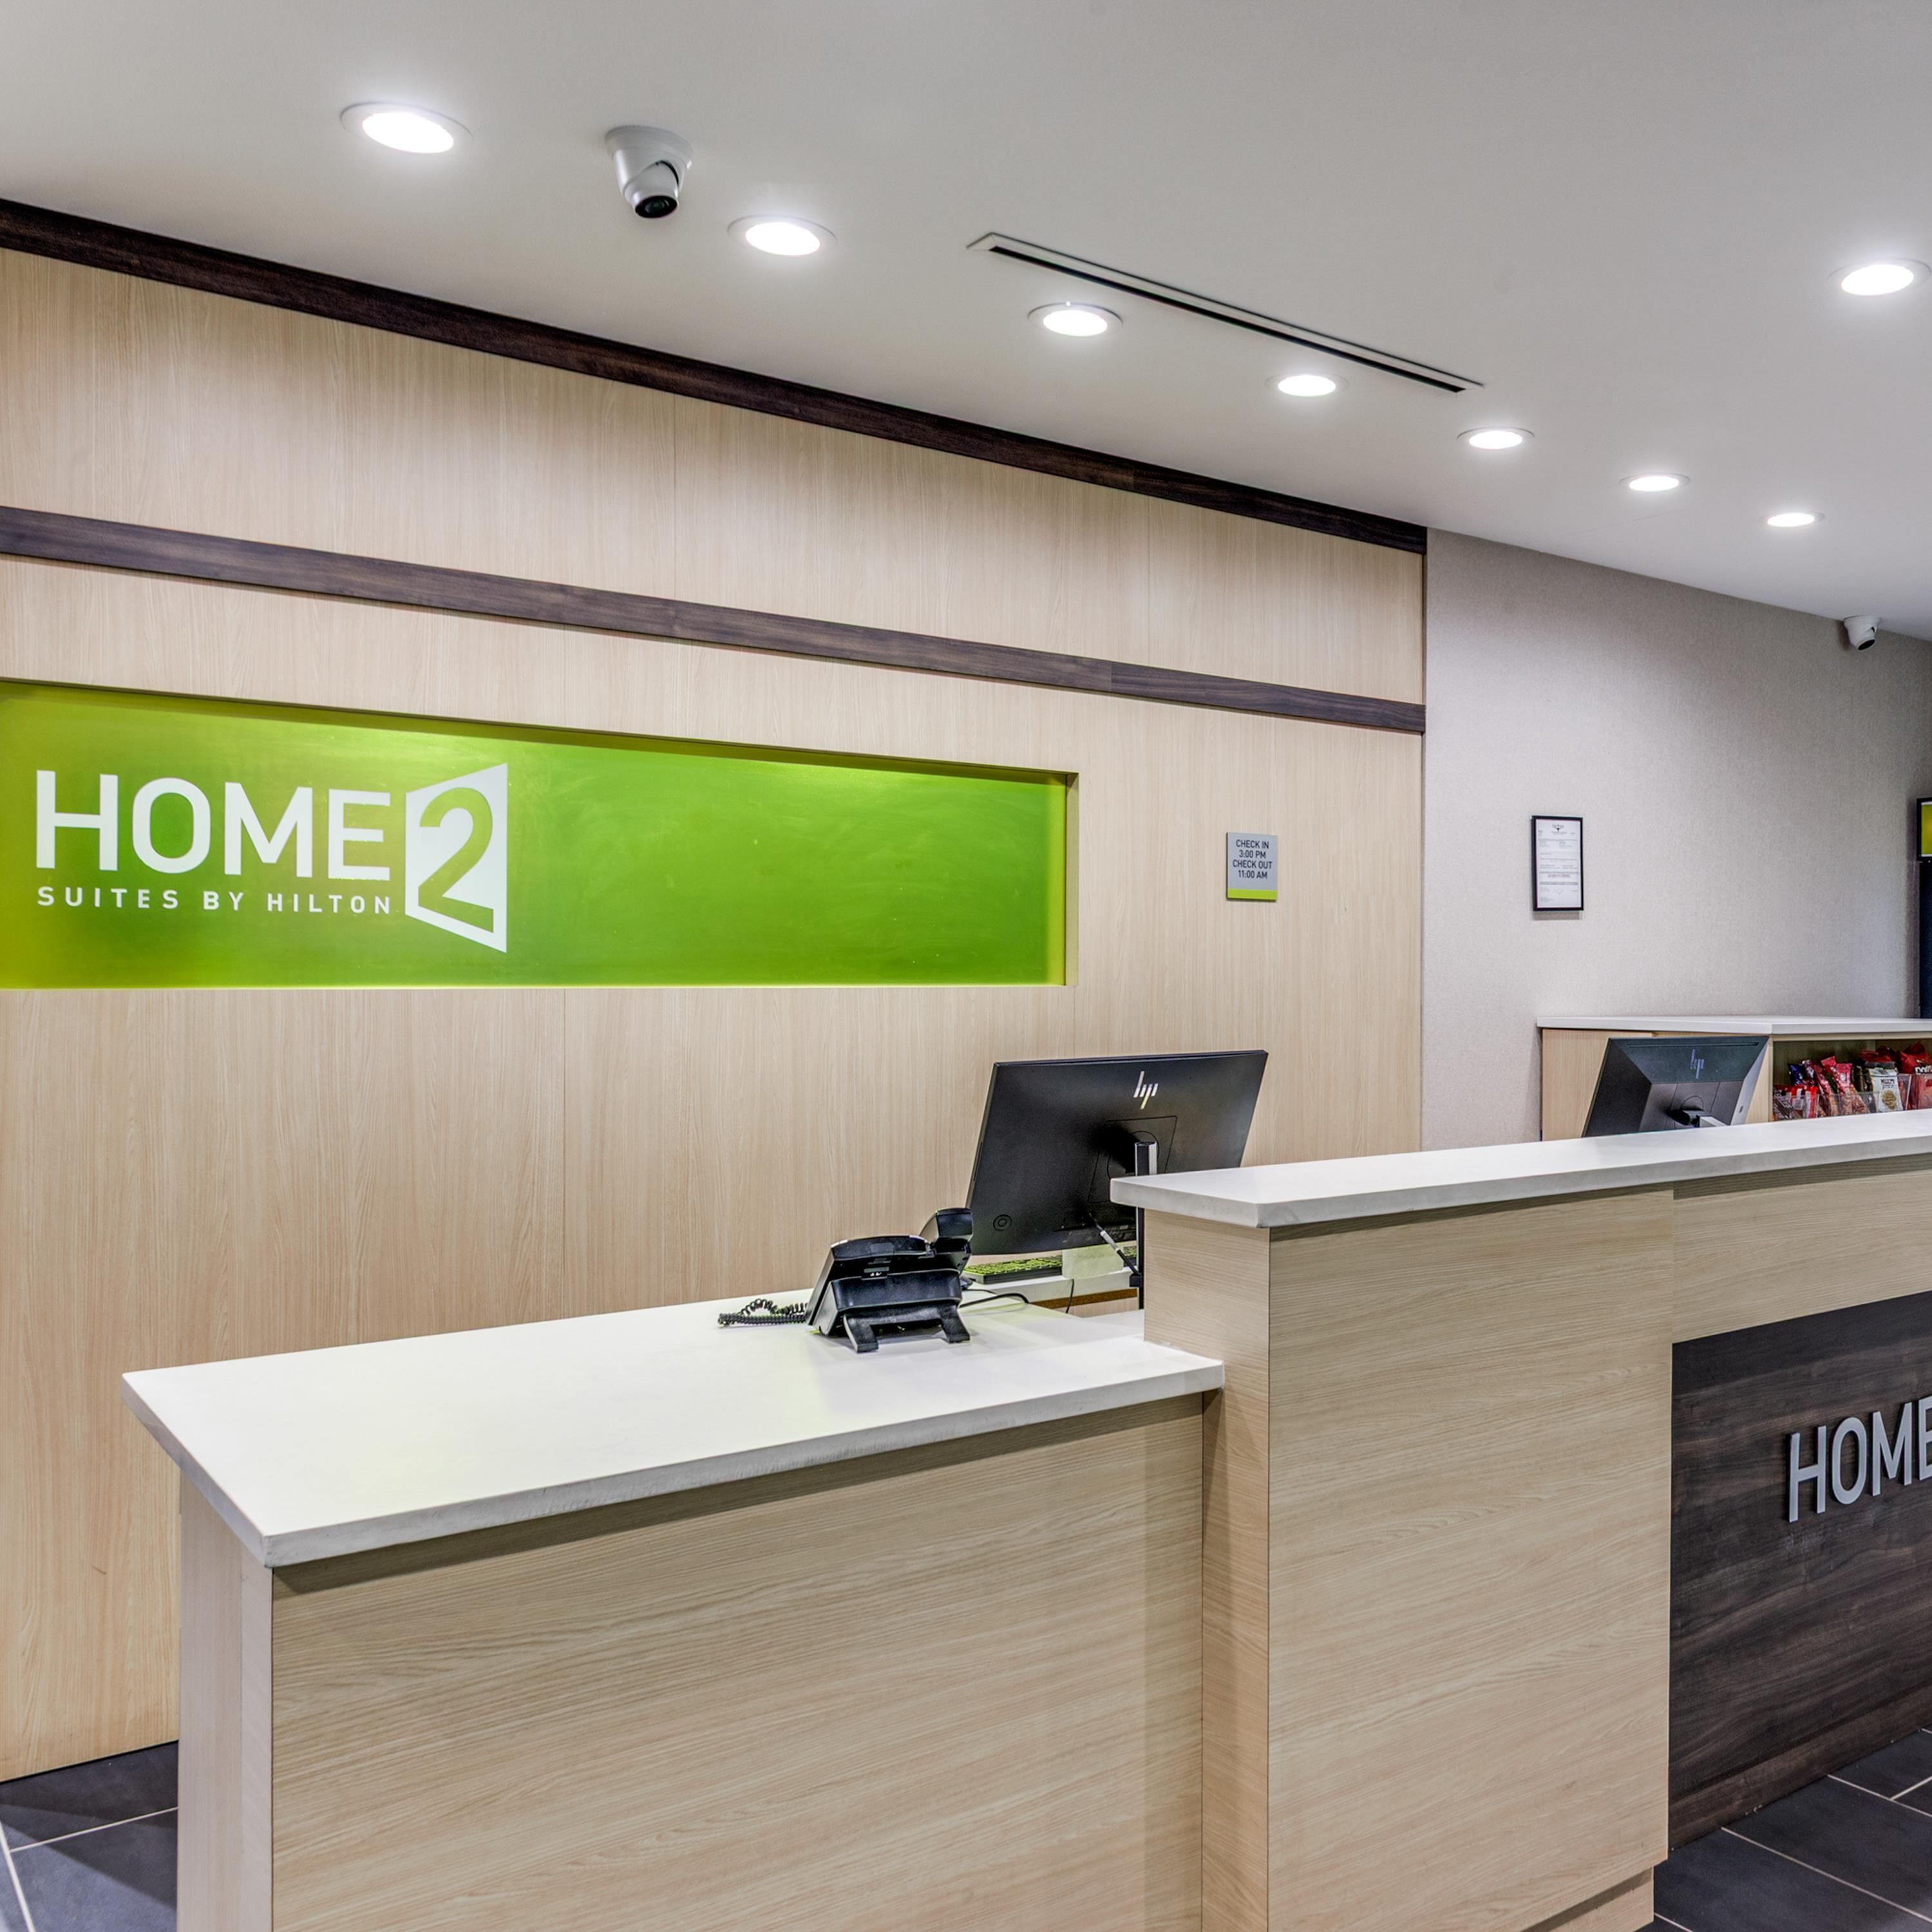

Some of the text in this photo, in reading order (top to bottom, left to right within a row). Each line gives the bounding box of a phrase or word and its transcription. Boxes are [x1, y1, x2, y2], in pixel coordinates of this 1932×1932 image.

[36, 770, 495, 933] HOME 2
[1236, 839, 1269, 849] CHECK IN
[1239, 849, 1266, 859] 3:00 PM
[1232, 859, 1273, 869] CHECK OUT
[1238, 869, 1268, 879] 11:00 AM
[37, 886, 391, 914] SUITES BY HILTON
[1690, 1048, 1705, 1079] hp
[1133, 1070, 1159, 1110] hp
